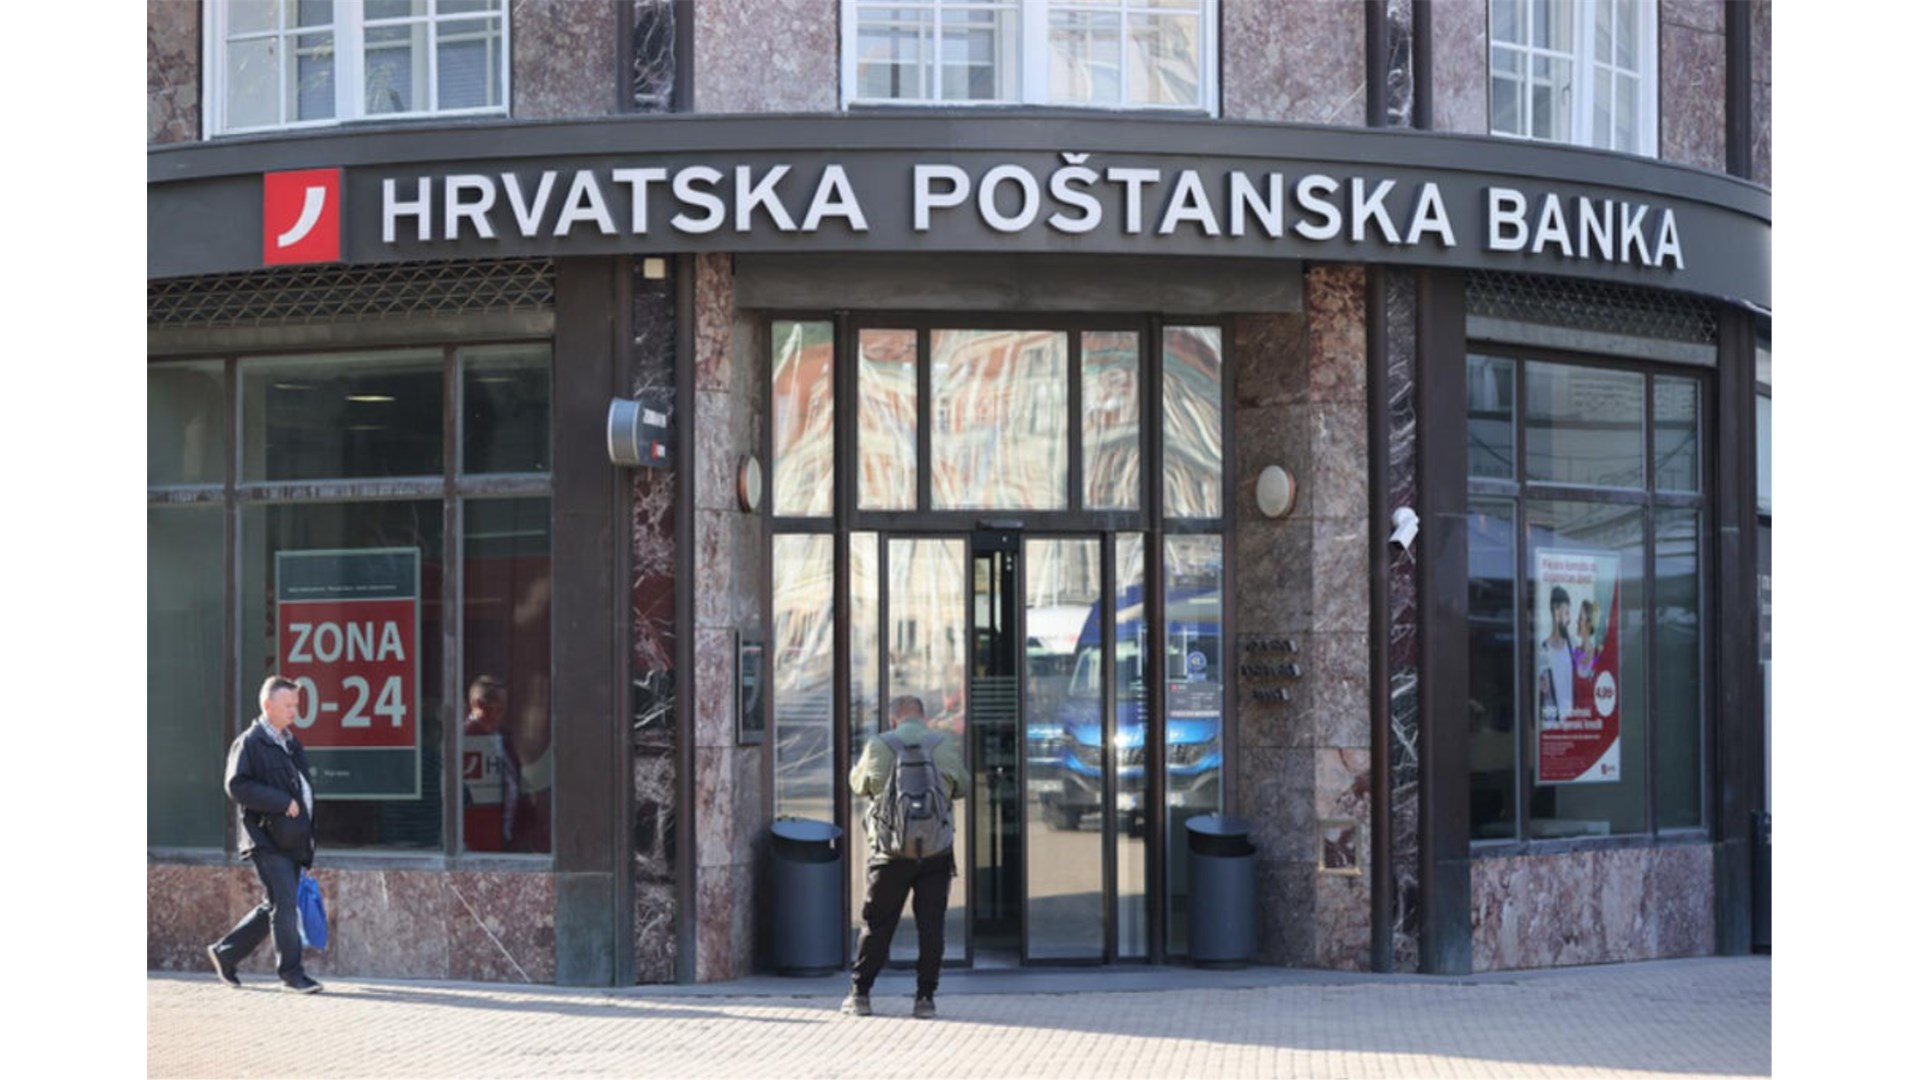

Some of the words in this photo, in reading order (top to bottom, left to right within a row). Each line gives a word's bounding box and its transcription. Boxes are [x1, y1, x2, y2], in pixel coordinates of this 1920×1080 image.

[382, 164, 869, 243] HRVATSKA
[913, 152, 1457, 247] POŠTANSKA
[1487, 186, 1685, 270] BANKA
[287, 621, 406, 663] ZONA
[292, 675, 407, 729] 0-24
